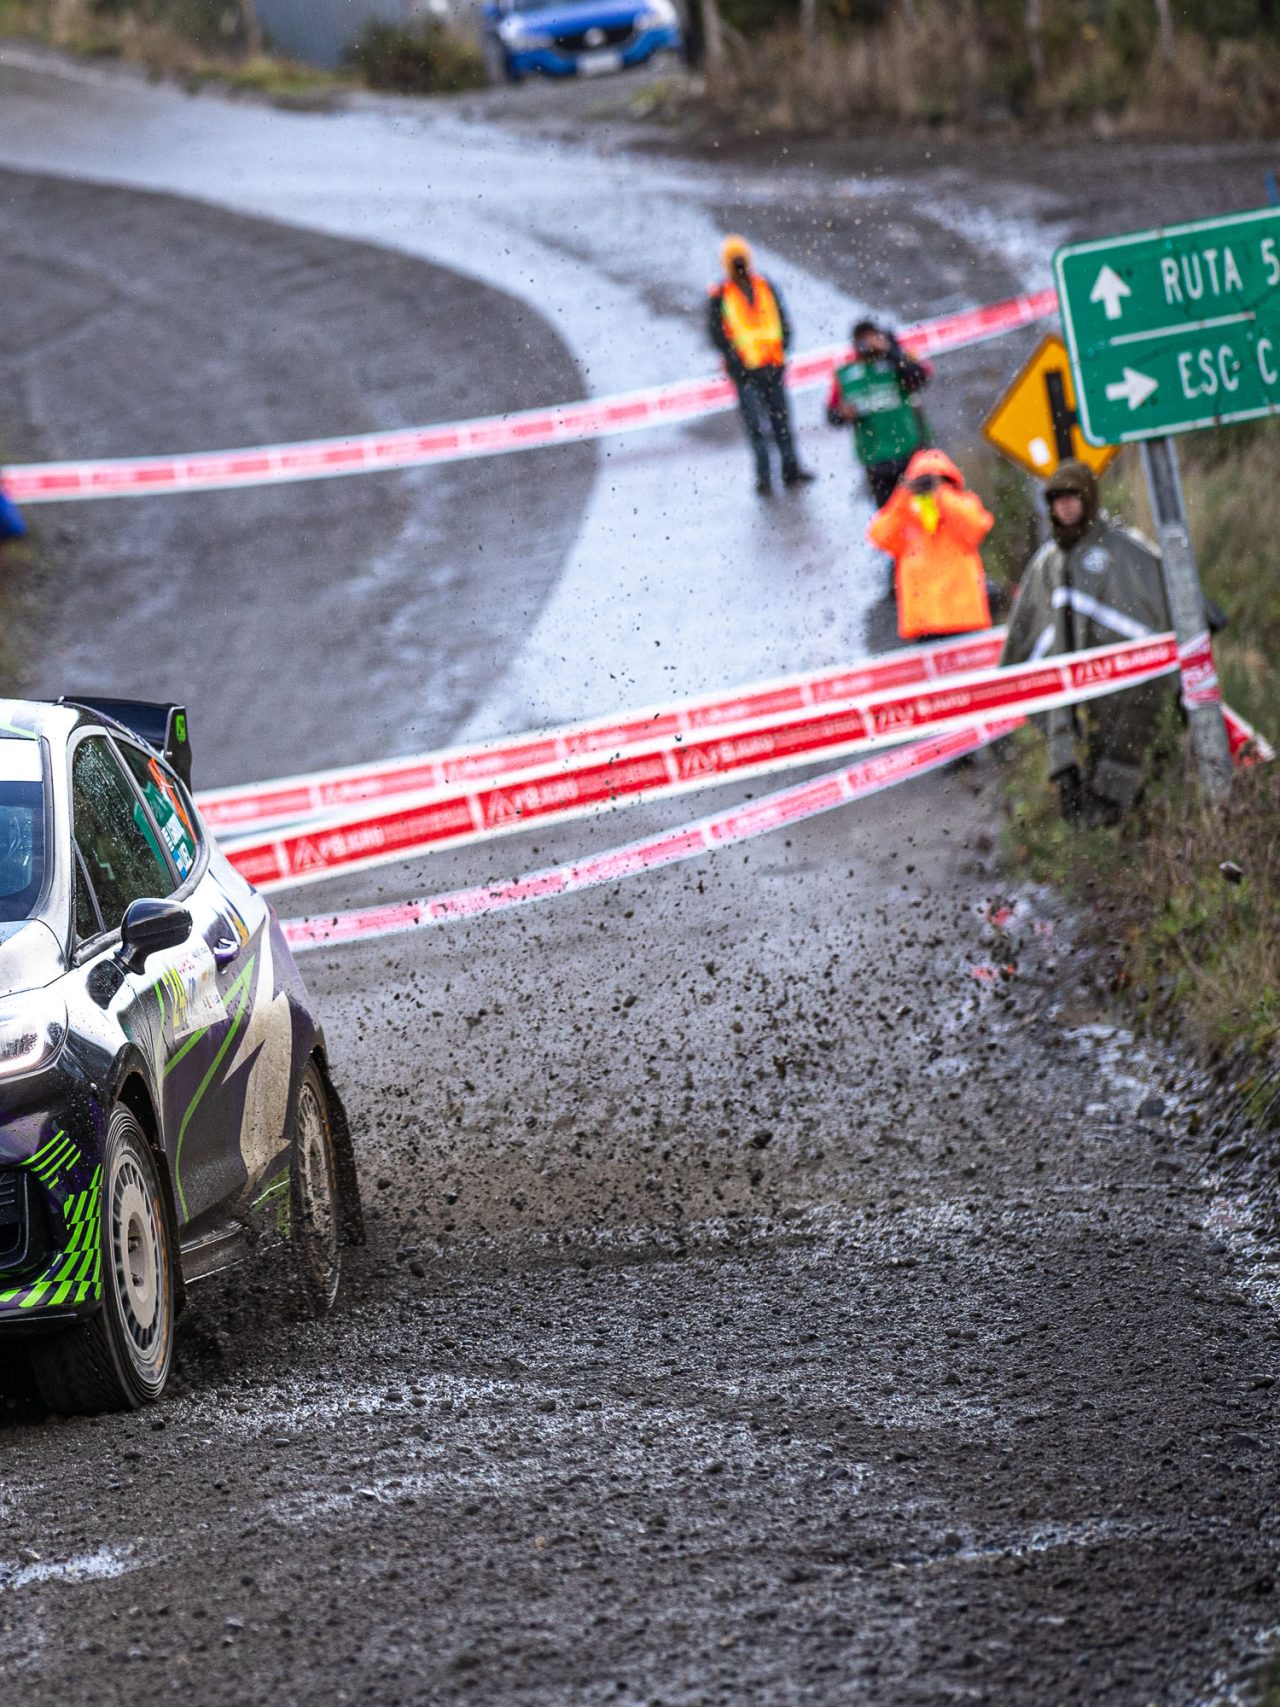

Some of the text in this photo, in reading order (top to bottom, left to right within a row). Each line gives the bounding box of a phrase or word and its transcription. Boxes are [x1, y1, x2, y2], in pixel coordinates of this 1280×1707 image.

[1160, 238, 1280, 305] RUTA 5
[1177, 338, 1279, 400] ESC C
